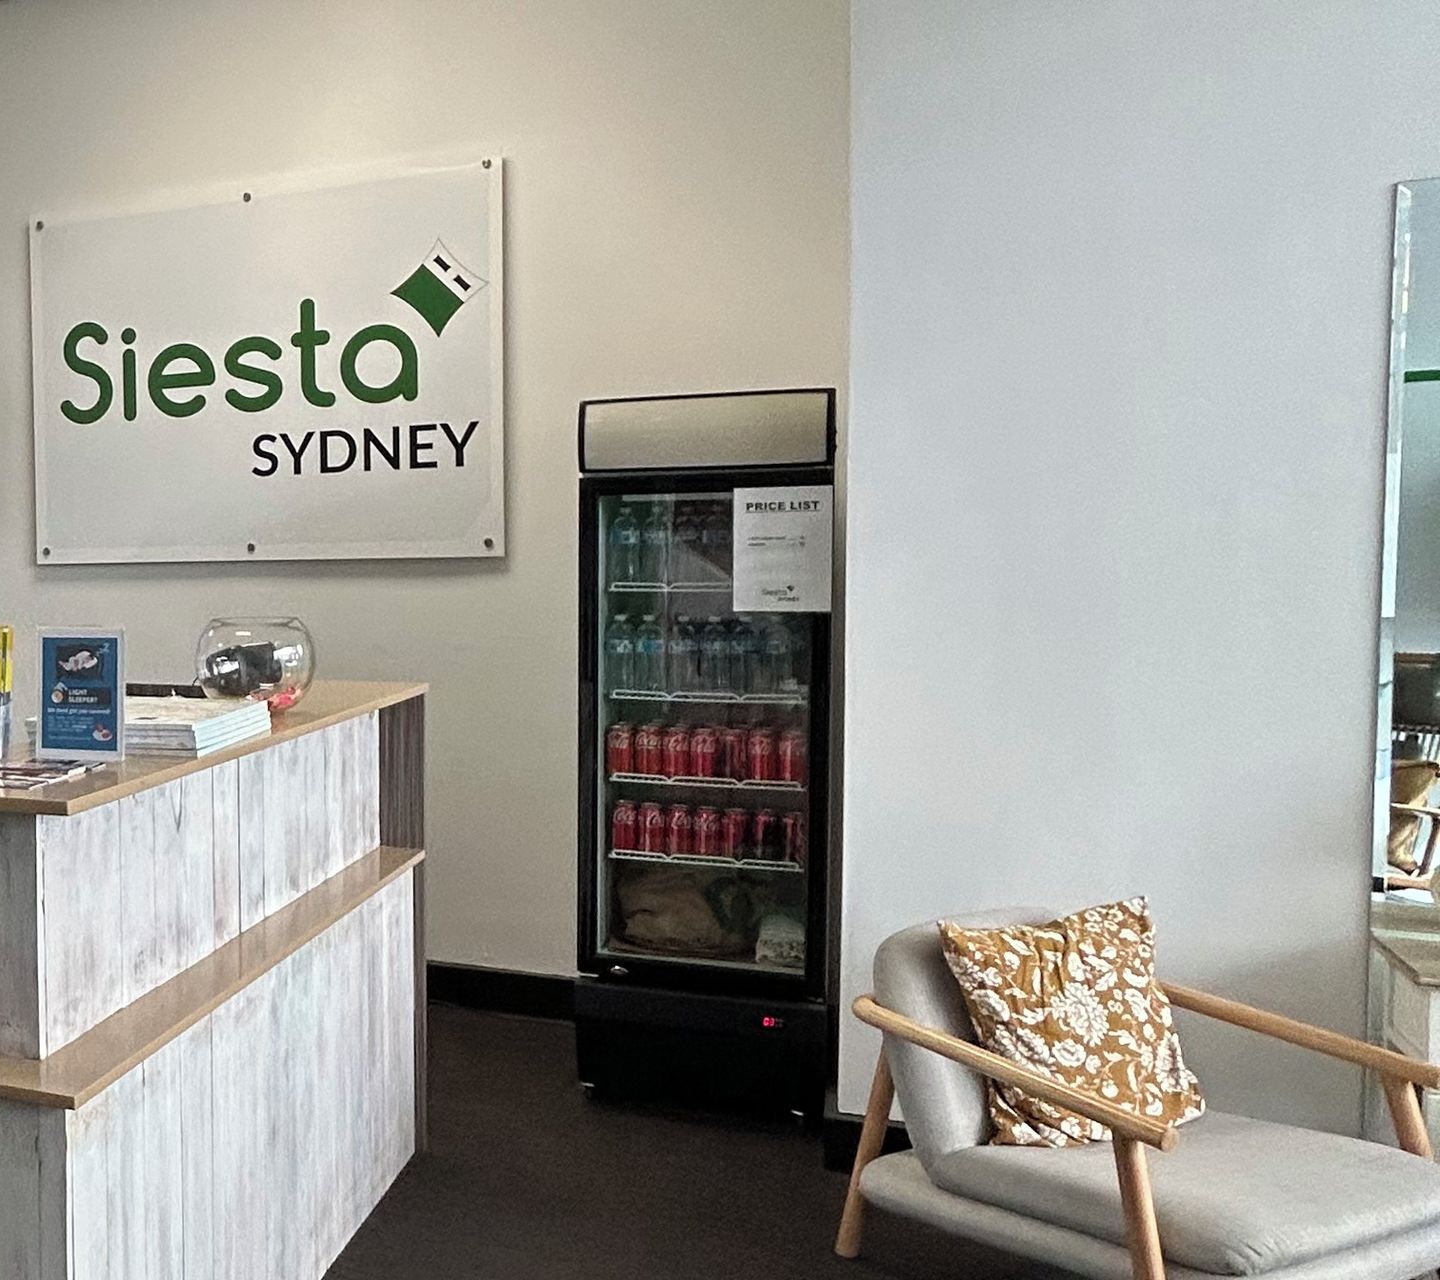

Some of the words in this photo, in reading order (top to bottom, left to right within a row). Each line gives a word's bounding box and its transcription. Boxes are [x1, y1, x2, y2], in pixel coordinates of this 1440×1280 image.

[60, 298, 418, 424] Siesta
[252, 421, 479, 477] SYDNEY
[746, 502, 785, 511] PRICE
[790, 501, 819, 510] LIST
